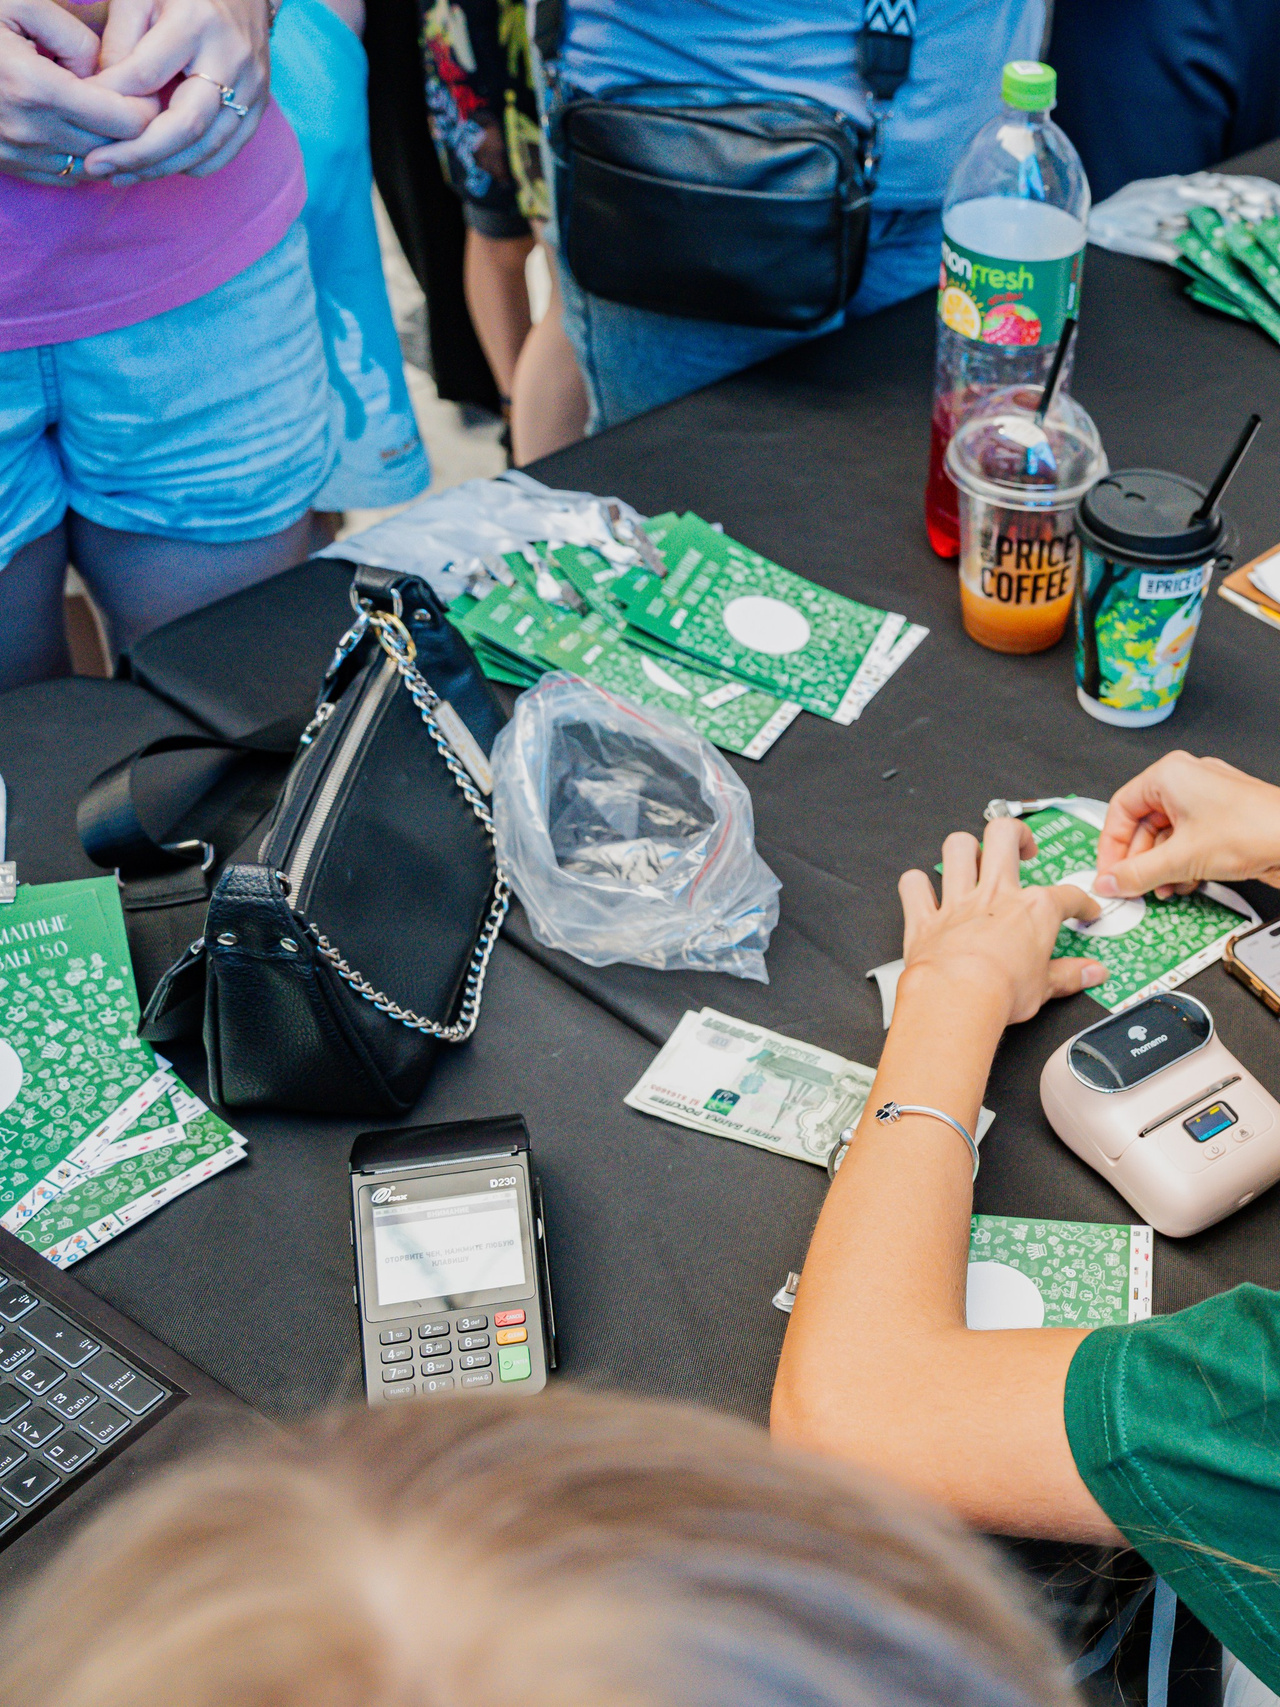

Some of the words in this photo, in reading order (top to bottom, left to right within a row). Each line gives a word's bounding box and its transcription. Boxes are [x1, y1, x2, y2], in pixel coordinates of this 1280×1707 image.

[996, 531, 1076, 569] PRICE
[981, 566, 1071, 605] COFFEE
[1155, 576, 1191, 593] PRICE
[1130, 1033, 1168, 1058] Phomemo
[489, 1176, 516, 1188] D230
[426, 1206, 470, 1219] ВНИМАНИЕ
[384, 1251, 424, 1264] ОТОРВИТЕ
[444, 1244, 484, 1257] НАЖМИТЕ
[485, 1239, 515, 1251] ЛЮБУЮ
[431, 1255, 470, 1268] КЛАВИШУ
[424, 1324, 432, 1334] 2
[462, 1318, 470, 1328] 3
[388, 1330, 394, 1341] 1
[464, 1336, 472, 1347] 6
[387, 1349, 395, 1359] 4
[426, 1343, 433, 1354] 5
[3, 1347, 26, 1366] PgUp
[466, 1356, 474, 1366] 9
[390, 1368, 397, 1378] 7
[427, 1362, 434, 1372] 8
[22, 1370, 35, 1380] 6
[108, 1370, 132, 1390] Enter
[466, 1374, 484, 1383] ALPHA
[429, 1380, 436, 1391] 0
[52, 1392, 67, 1404] 3
[66, 1394, 90, 1413] PgDn
[18, 1420, 32, 1432] 2
[98, 1424, 115, 1438] Del
[63, 1454, 79, 1466] Ins
